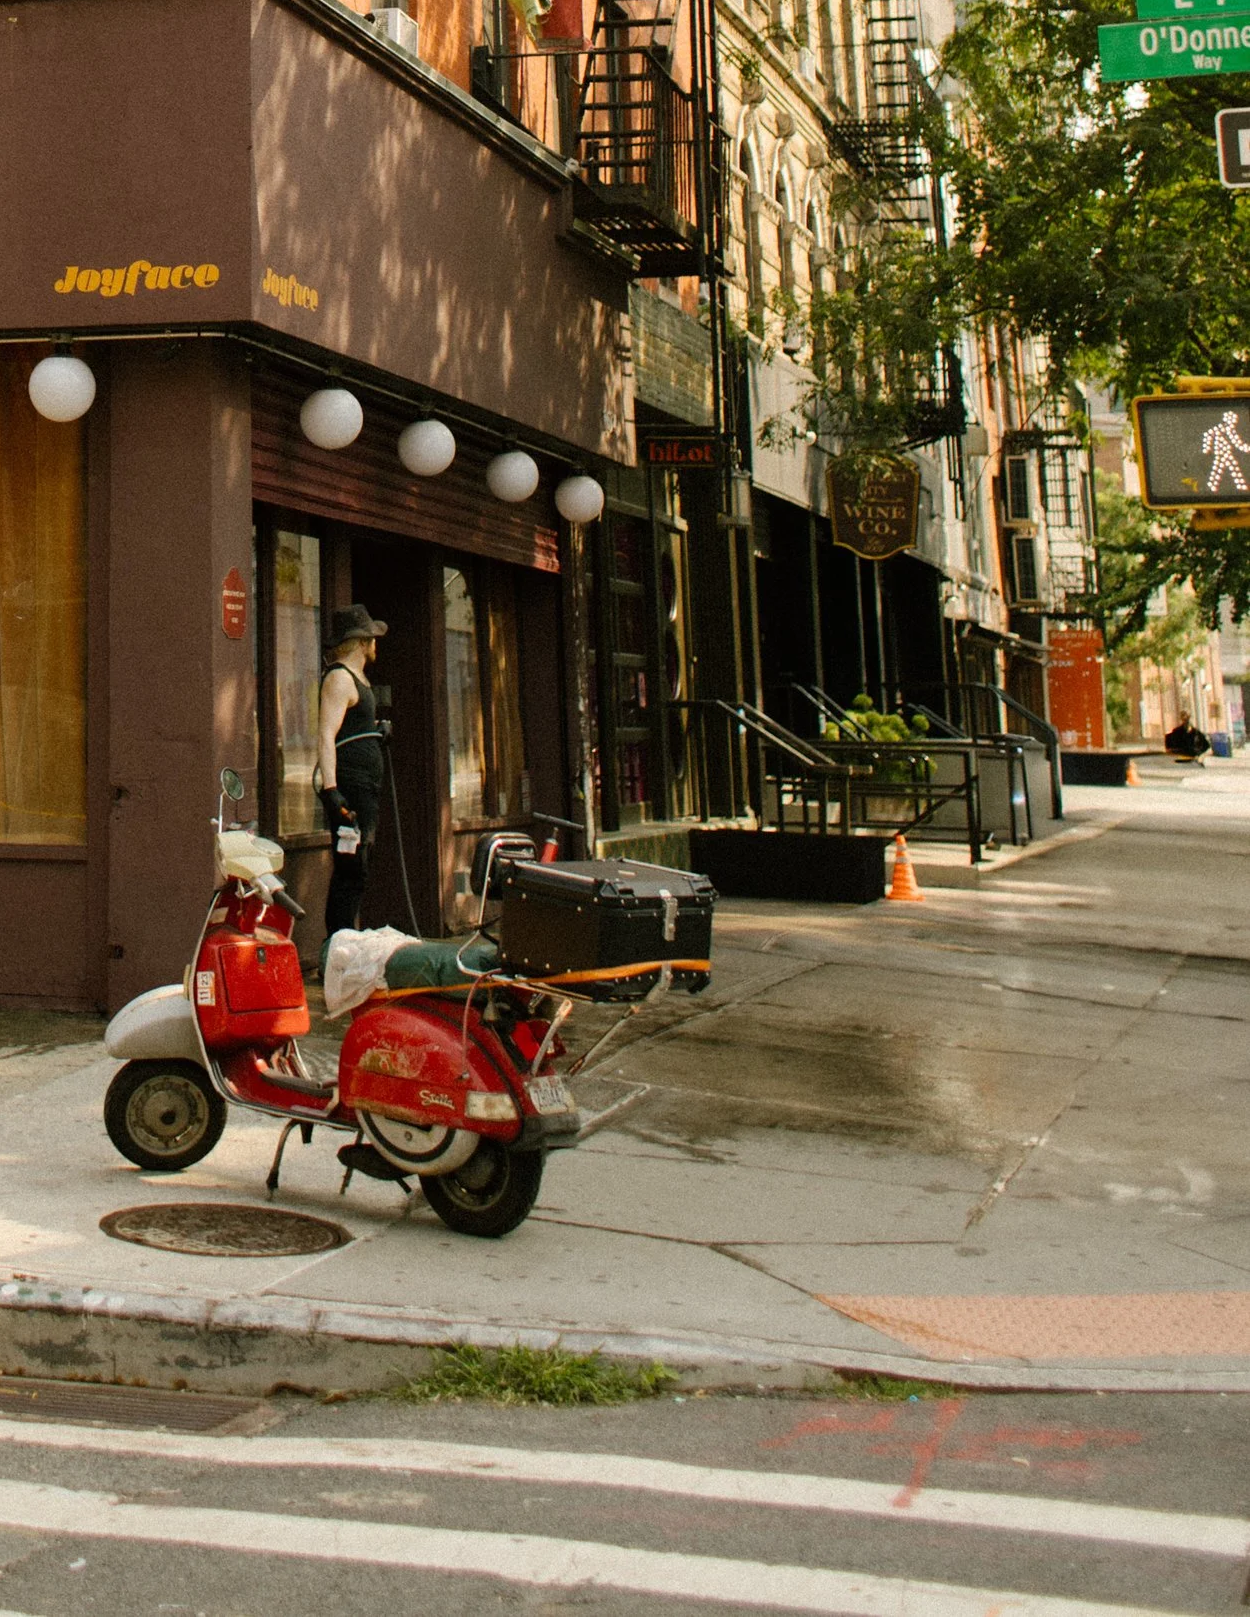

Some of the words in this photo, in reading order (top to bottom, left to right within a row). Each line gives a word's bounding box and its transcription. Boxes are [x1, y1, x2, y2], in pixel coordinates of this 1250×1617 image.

[1192, 54, 1222, 72] Way
[54, 260, 220, 297] Joyface
[262, 267, 319, 312] Joyface
[843, 503, 906, 519] WINE
[858, 520, 897, 535] CO.
